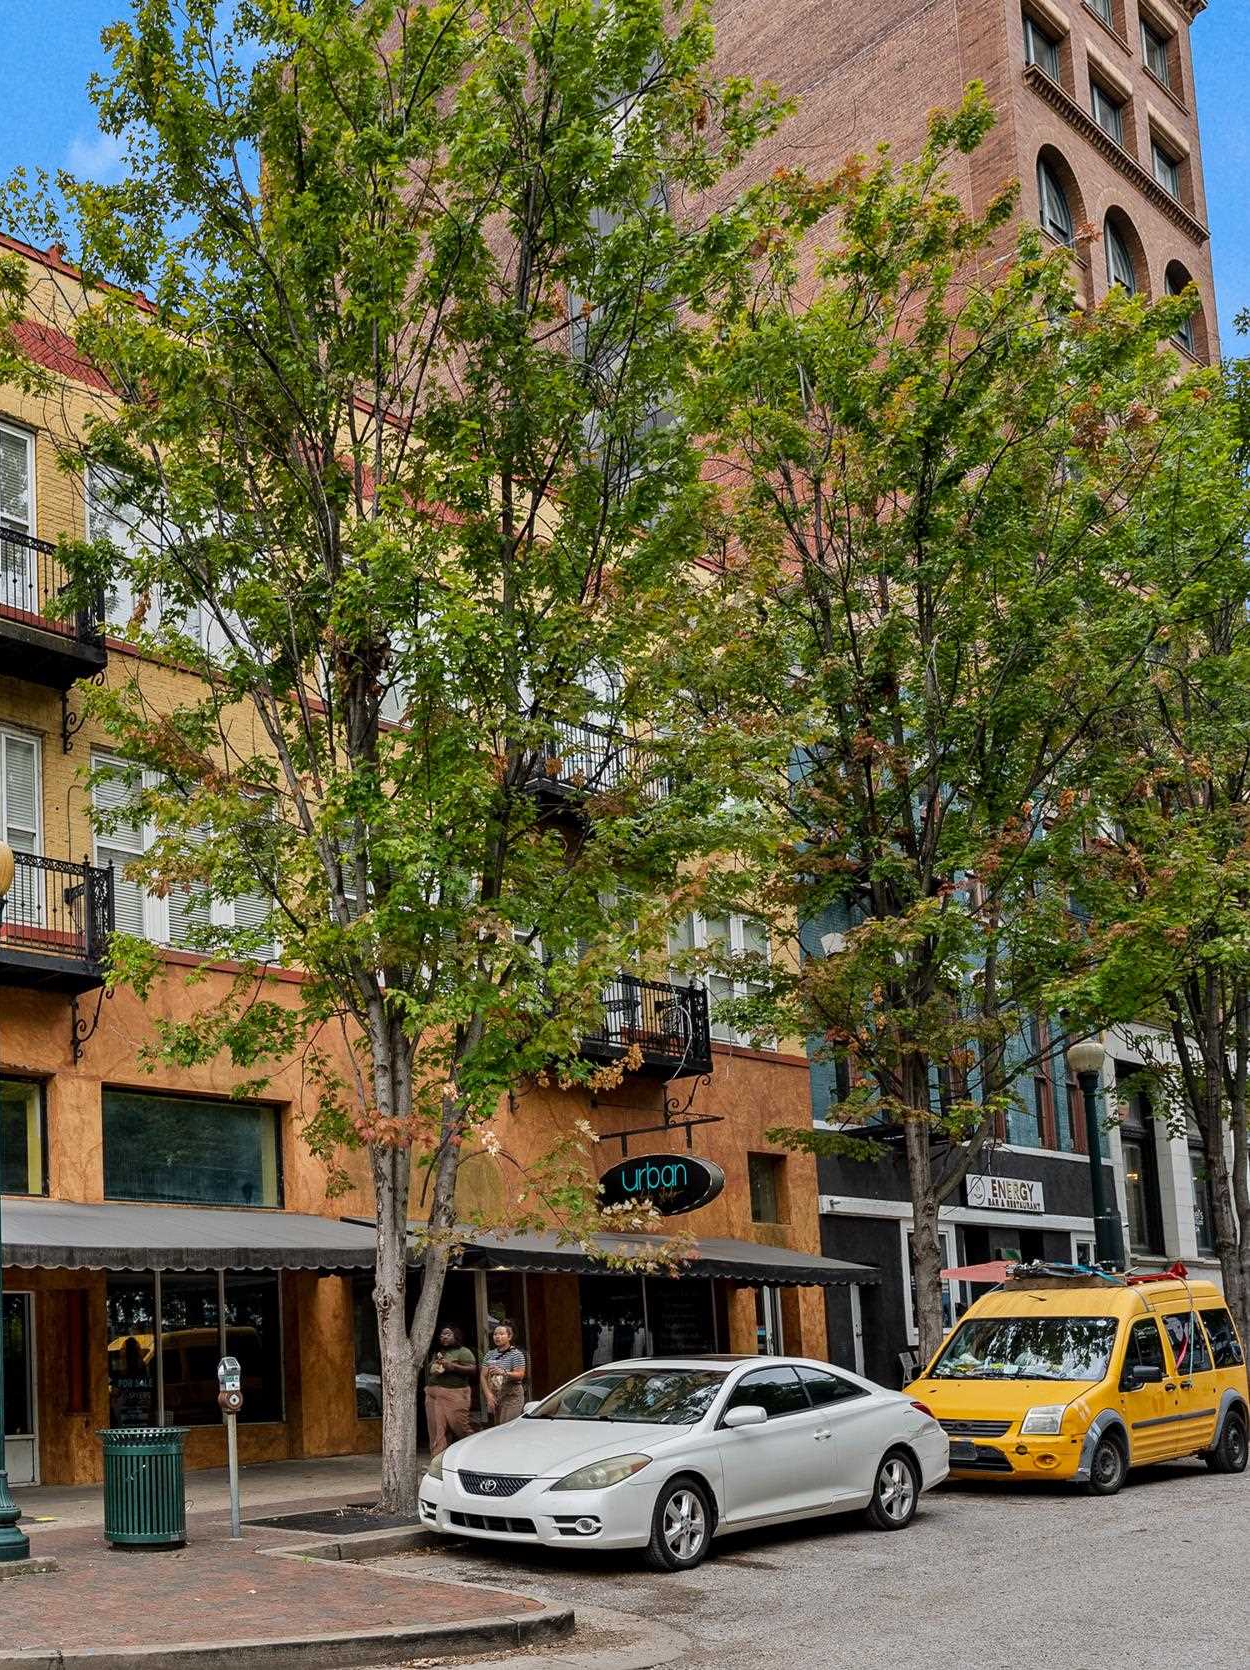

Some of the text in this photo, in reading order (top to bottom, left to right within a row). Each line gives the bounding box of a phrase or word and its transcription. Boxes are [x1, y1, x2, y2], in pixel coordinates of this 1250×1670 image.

[621, 1162, 688, 1192] urban
[991, 1179, 1034, 1202] ENERGY
[988, 1198, 1000, 1207] BAR
[1006, 1201, 1040, 1210] RESTAURANT
